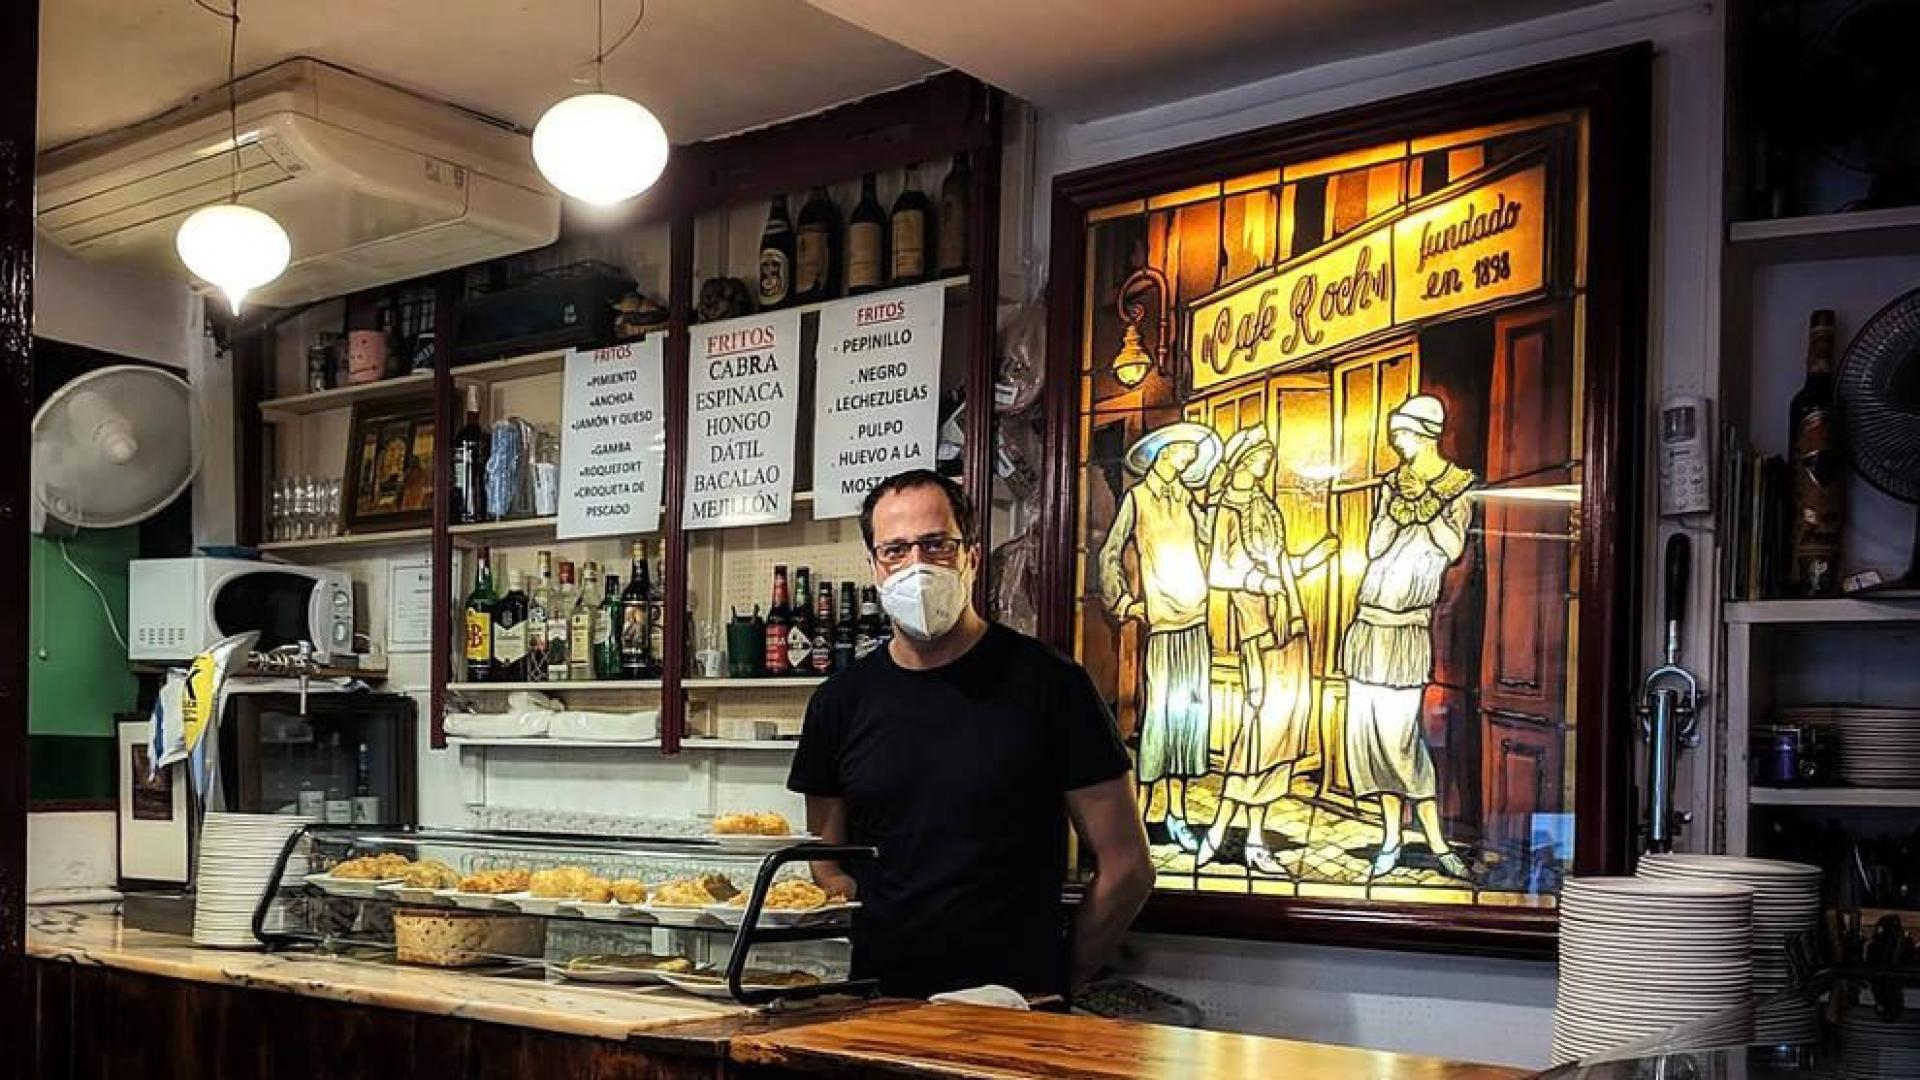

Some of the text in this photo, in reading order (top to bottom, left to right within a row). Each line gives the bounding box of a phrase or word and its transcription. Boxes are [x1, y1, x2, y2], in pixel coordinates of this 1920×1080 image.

[1416, 191, 1521, 273] fundado
[857, 301, 905, 324] FRITOS
[706, 325, 776, 359] FRITOS
[843, 328, 913, 354] PEPINILLO
[709, 353, 779, 381] CABRA
[858, 362, 907, 383] NEGRO
[696, 381, 784, 412] ESPINACA
[835, 384, 928, 412] LECHEZUELAS
[706, 410, 771, 437] HONGO
[858, 420, 903, 439] PULPO
[711, 438, 765, 464] DÁTIL
[839, 442, 922, 467] HUEVO A LA
[693, 464, 781, 493] BACALAO
[841, 477, 882, 494] MOST
